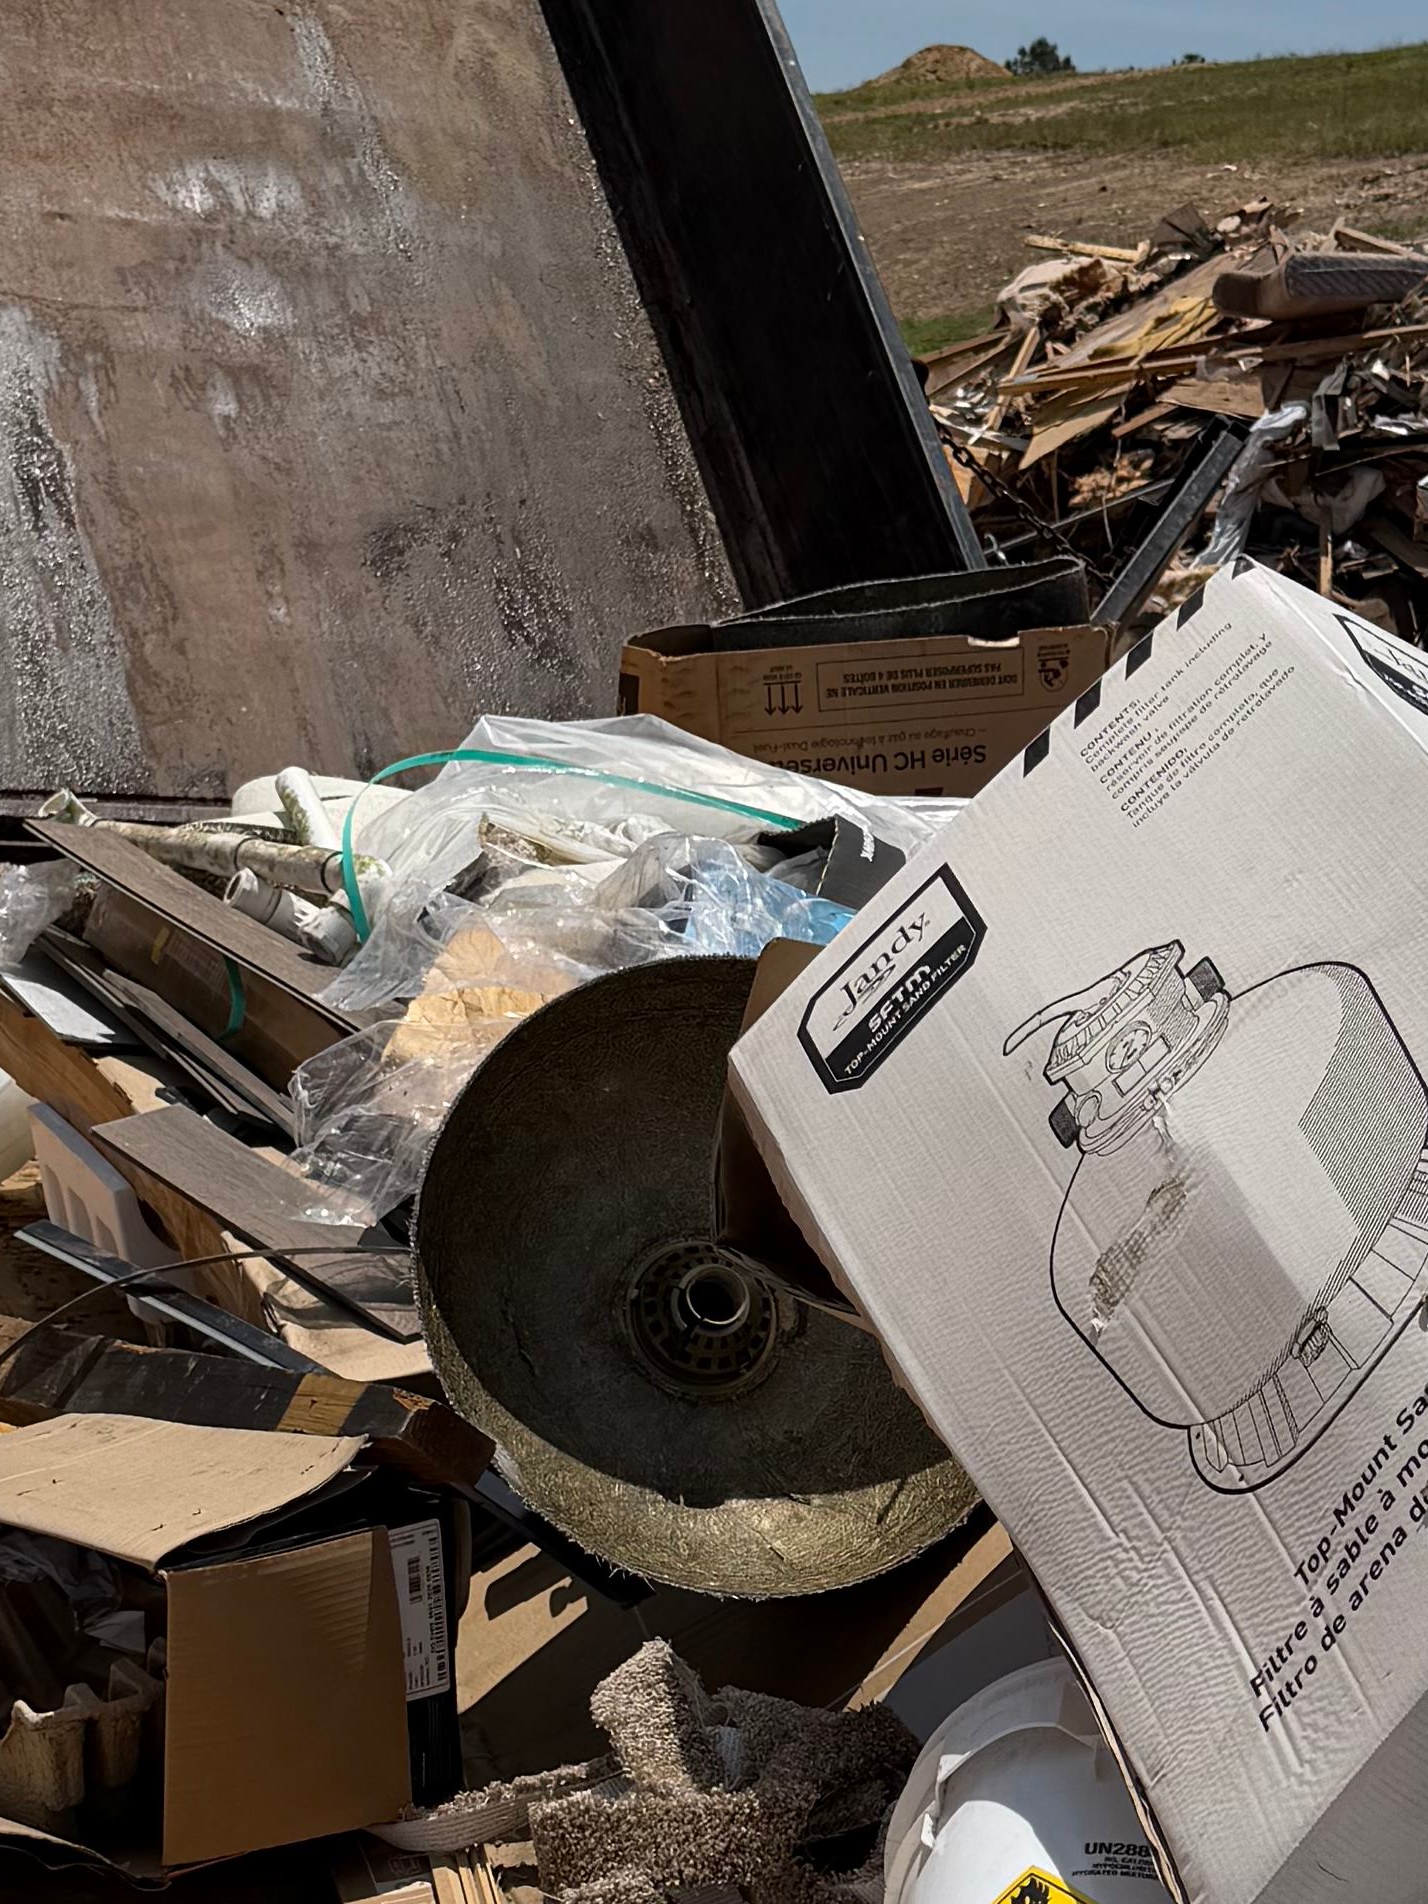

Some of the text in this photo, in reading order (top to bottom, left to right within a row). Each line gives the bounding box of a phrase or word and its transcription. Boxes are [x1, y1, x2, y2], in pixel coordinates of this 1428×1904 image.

[886, 670, 899, 681] DE
[900, 668, 923, 679] PLUS
[1085, 717, 1133, 764] Complete
[1134, 692, 1158, 717] filter
[1160, 669, 1184, 691] tank
[1154, 731, 1168, 745] de
[1168, 688, 1213, 730] filtration
[893, 744, 986, 771] Série HC
[1090, 695, 1169, 772] backwash valve
[1100, 731, 1152, 784] CONTENU
[1111, 758, 1154, 799] compris
[1196, 698, 1213, 715] de
[1126, 783, 1164, 819] Tanque
[1163, 765, 1181, 783] de
[1180, 742, 1206, 768] filtro
[1259, 668, 1279, 689] que
[1132, 792, 1170, 828] incluye
[1170, 780, 1182, 791] la
[1221, 727, 1235, 741] de
[844, 944, 966, 1074] TOP-MOUNT SAND FILTER
[1289, 1428, 1407, 1590] Top-Mount
[1367, 1480, 1401, 1514] à
[1315, 1504, 1388, 1599] sable
[1253, 1648, 1323, 1733] Filtro
[1308, 1602, 1353, 1655] de
[1338, 1520, 1413, 1612] arena
[1300, 1590, 1331, 1621] à
[1245, 1614, 1315, 1700] Filtre
